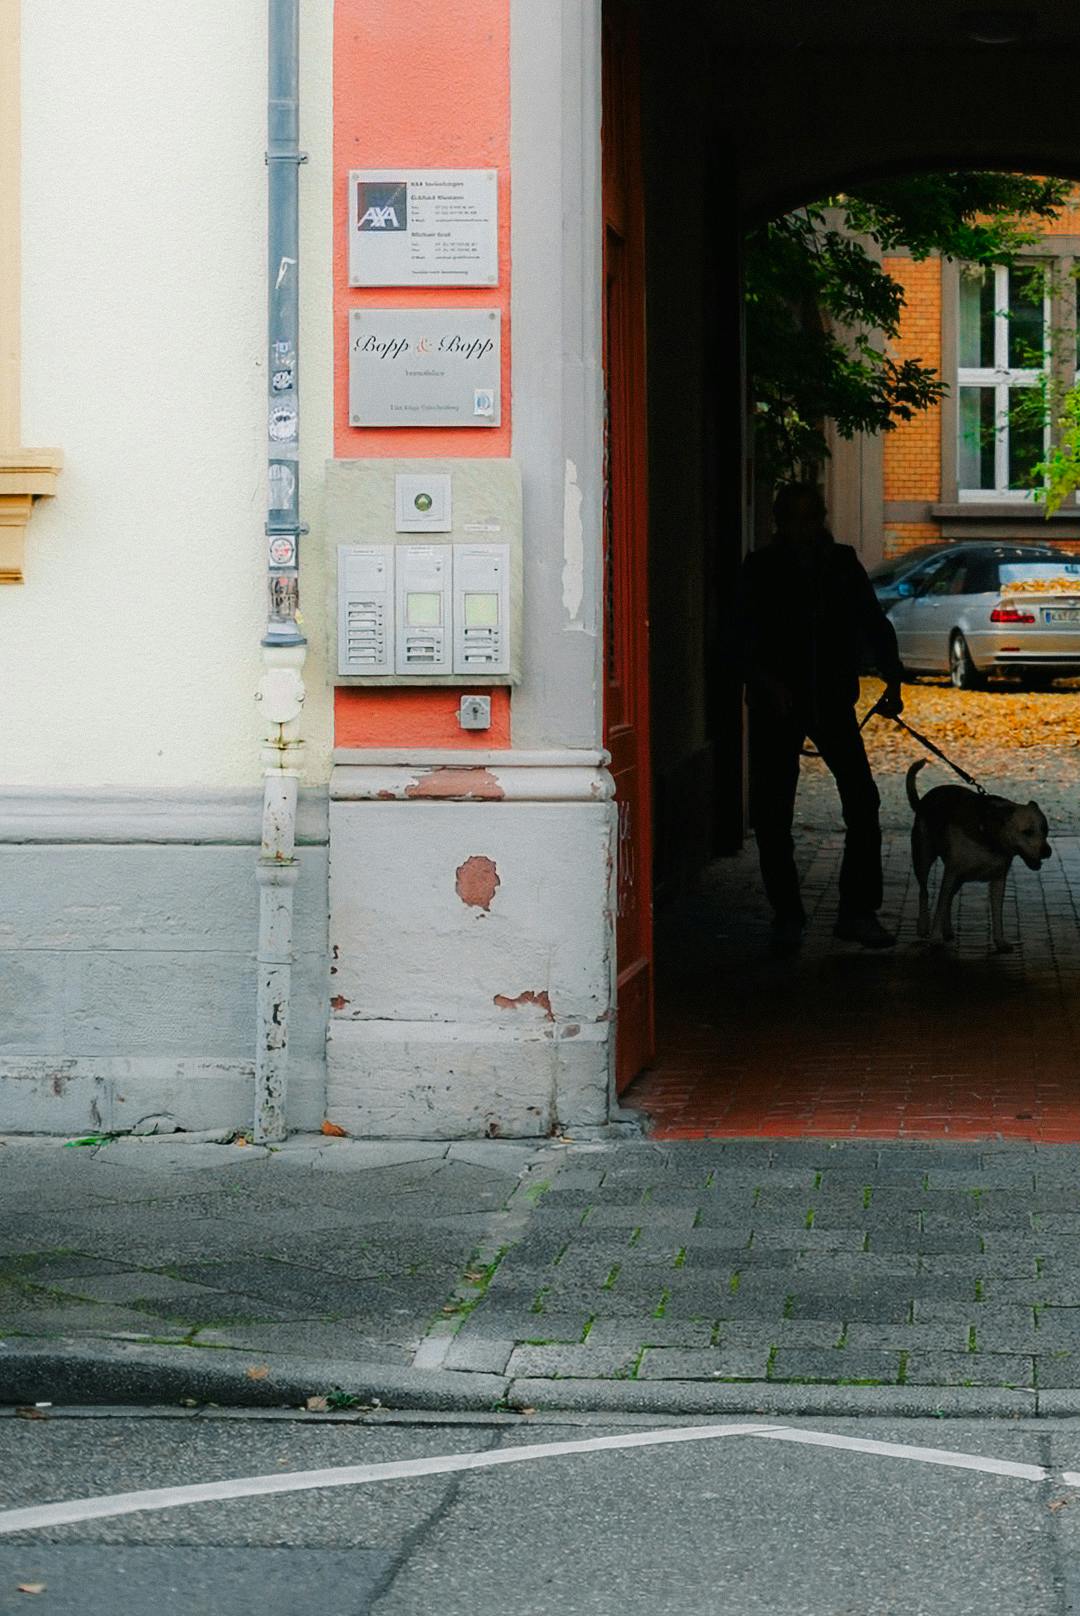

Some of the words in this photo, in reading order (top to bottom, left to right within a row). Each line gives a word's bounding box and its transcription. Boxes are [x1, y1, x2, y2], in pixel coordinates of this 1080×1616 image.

[357, 205, 400, 228] AXA
[353, 335, 409, 360] Bopp
[416, 336, 433, 353] &
[438, 335, 494, 360] Bopp
